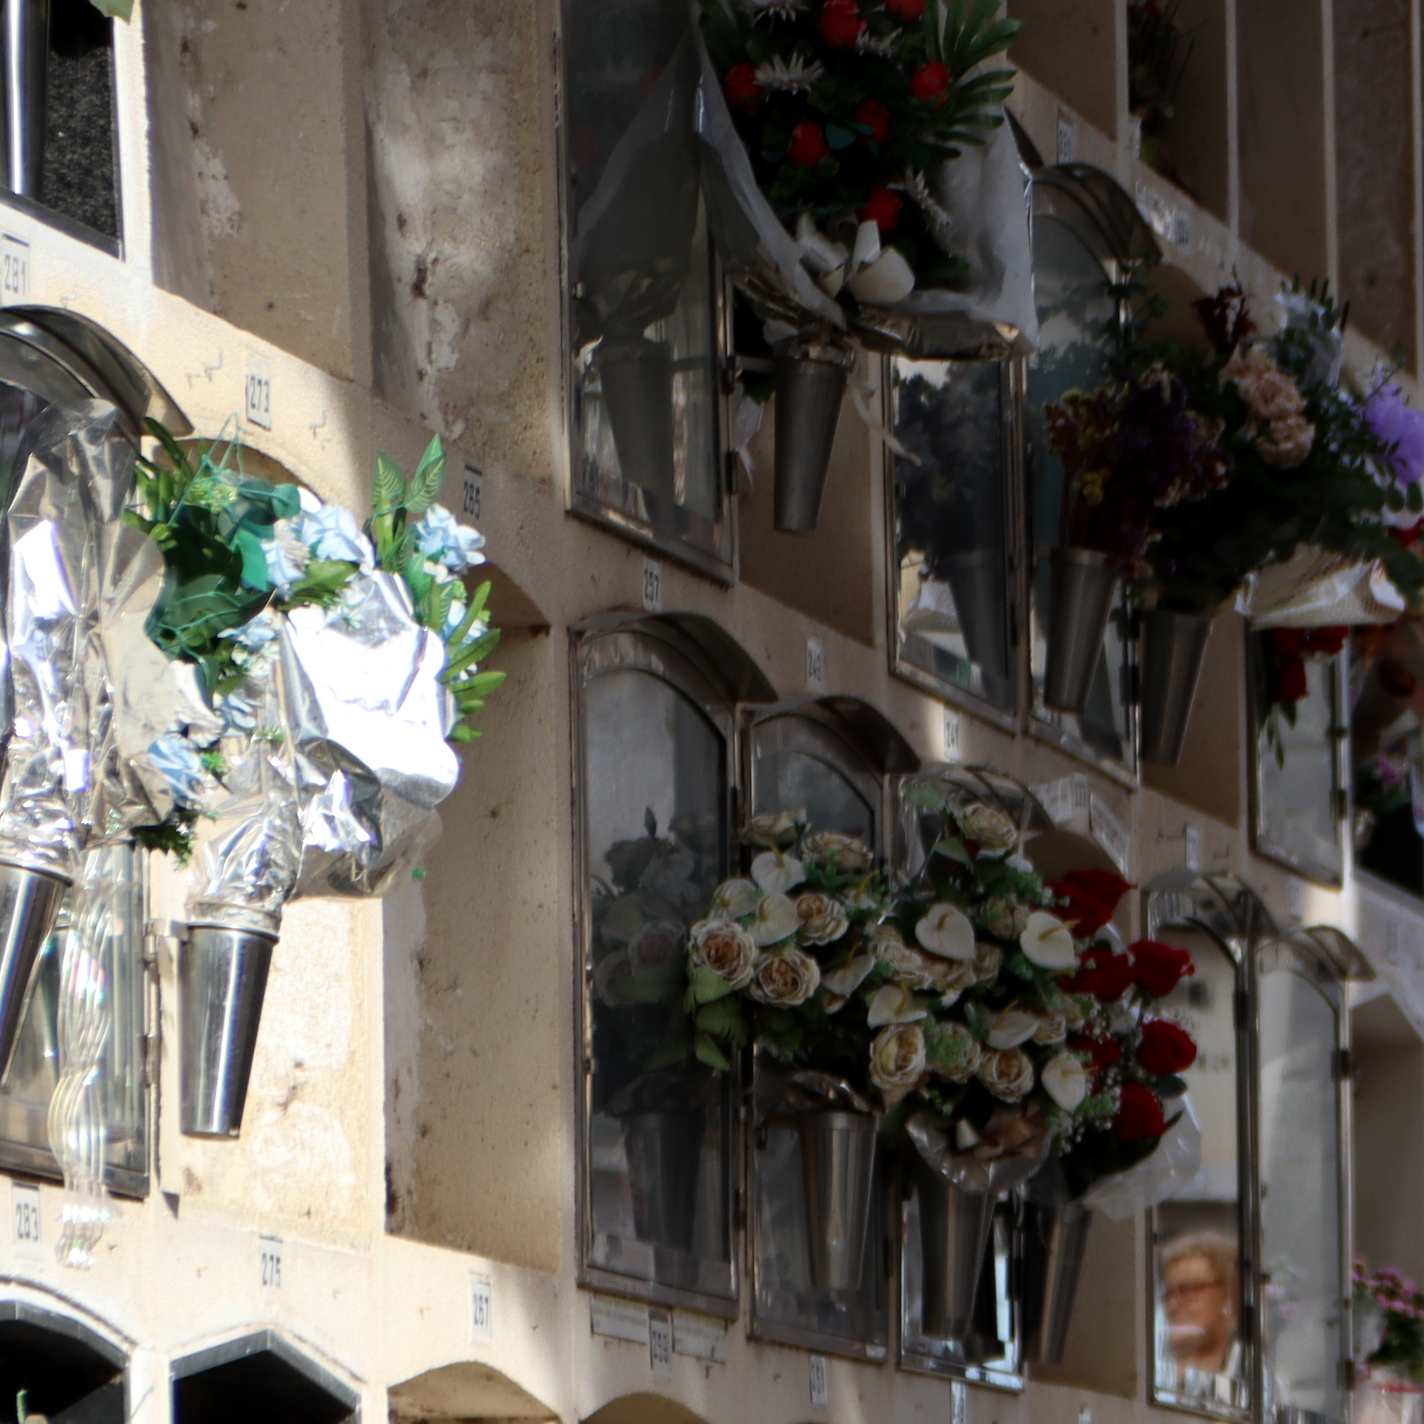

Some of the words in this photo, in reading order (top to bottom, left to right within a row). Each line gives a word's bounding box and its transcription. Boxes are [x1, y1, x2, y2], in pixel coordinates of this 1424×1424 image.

[4, 254, 26, 296] 281
[250, 376, 270, 413] 273
[644, 569, 659, 603] 257
[16, 1203, 38, 1242] 283
[262, 1253, 281, 1288] 275
[652, 1329, 669, 1364] 259
